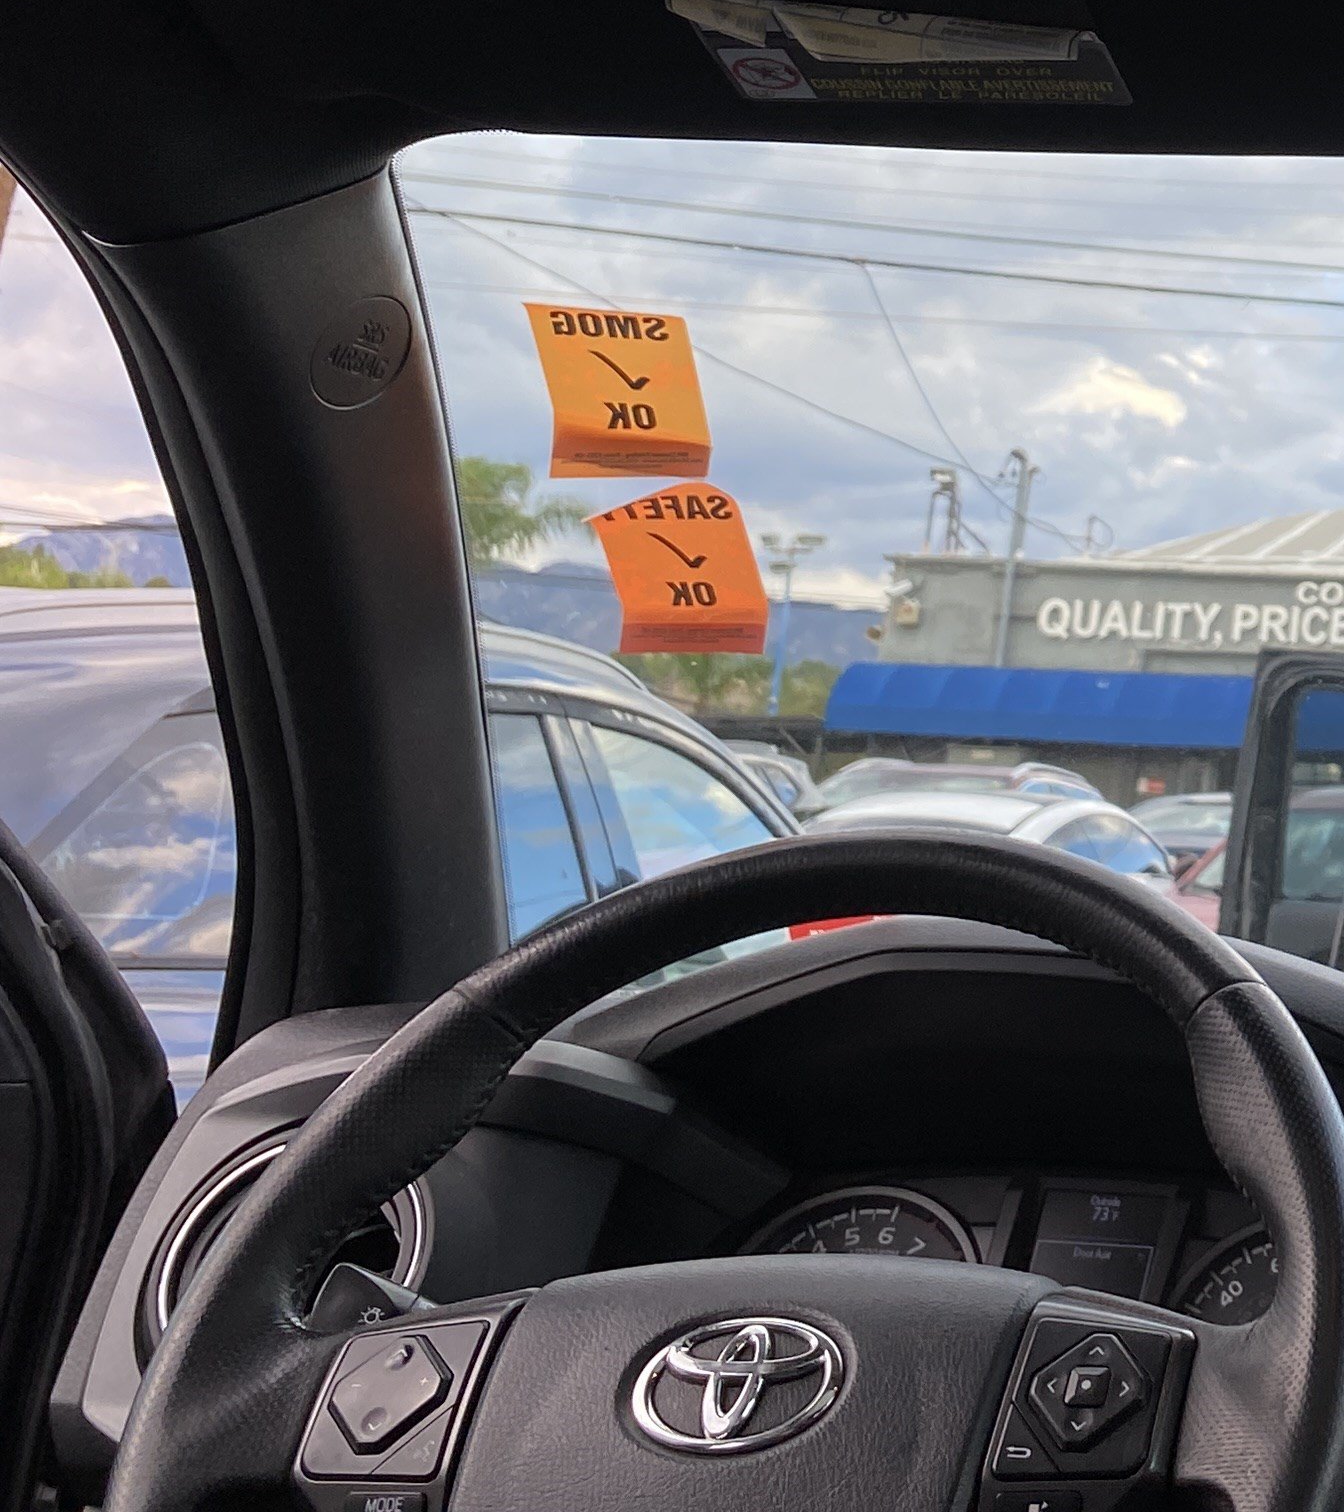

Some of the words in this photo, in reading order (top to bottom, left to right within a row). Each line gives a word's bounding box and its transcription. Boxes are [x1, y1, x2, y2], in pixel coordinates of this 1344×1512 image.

[1037, 597, 1224, 648] QUALITY,
[845, 1227, 860, 1247] 5
[878, 1226, 896, 1245] 6
[906, 1237, 927, 1256] 7
[1220, 1280, 1244, 1307] 40
[364, 1497, 406, 1512] MODE
